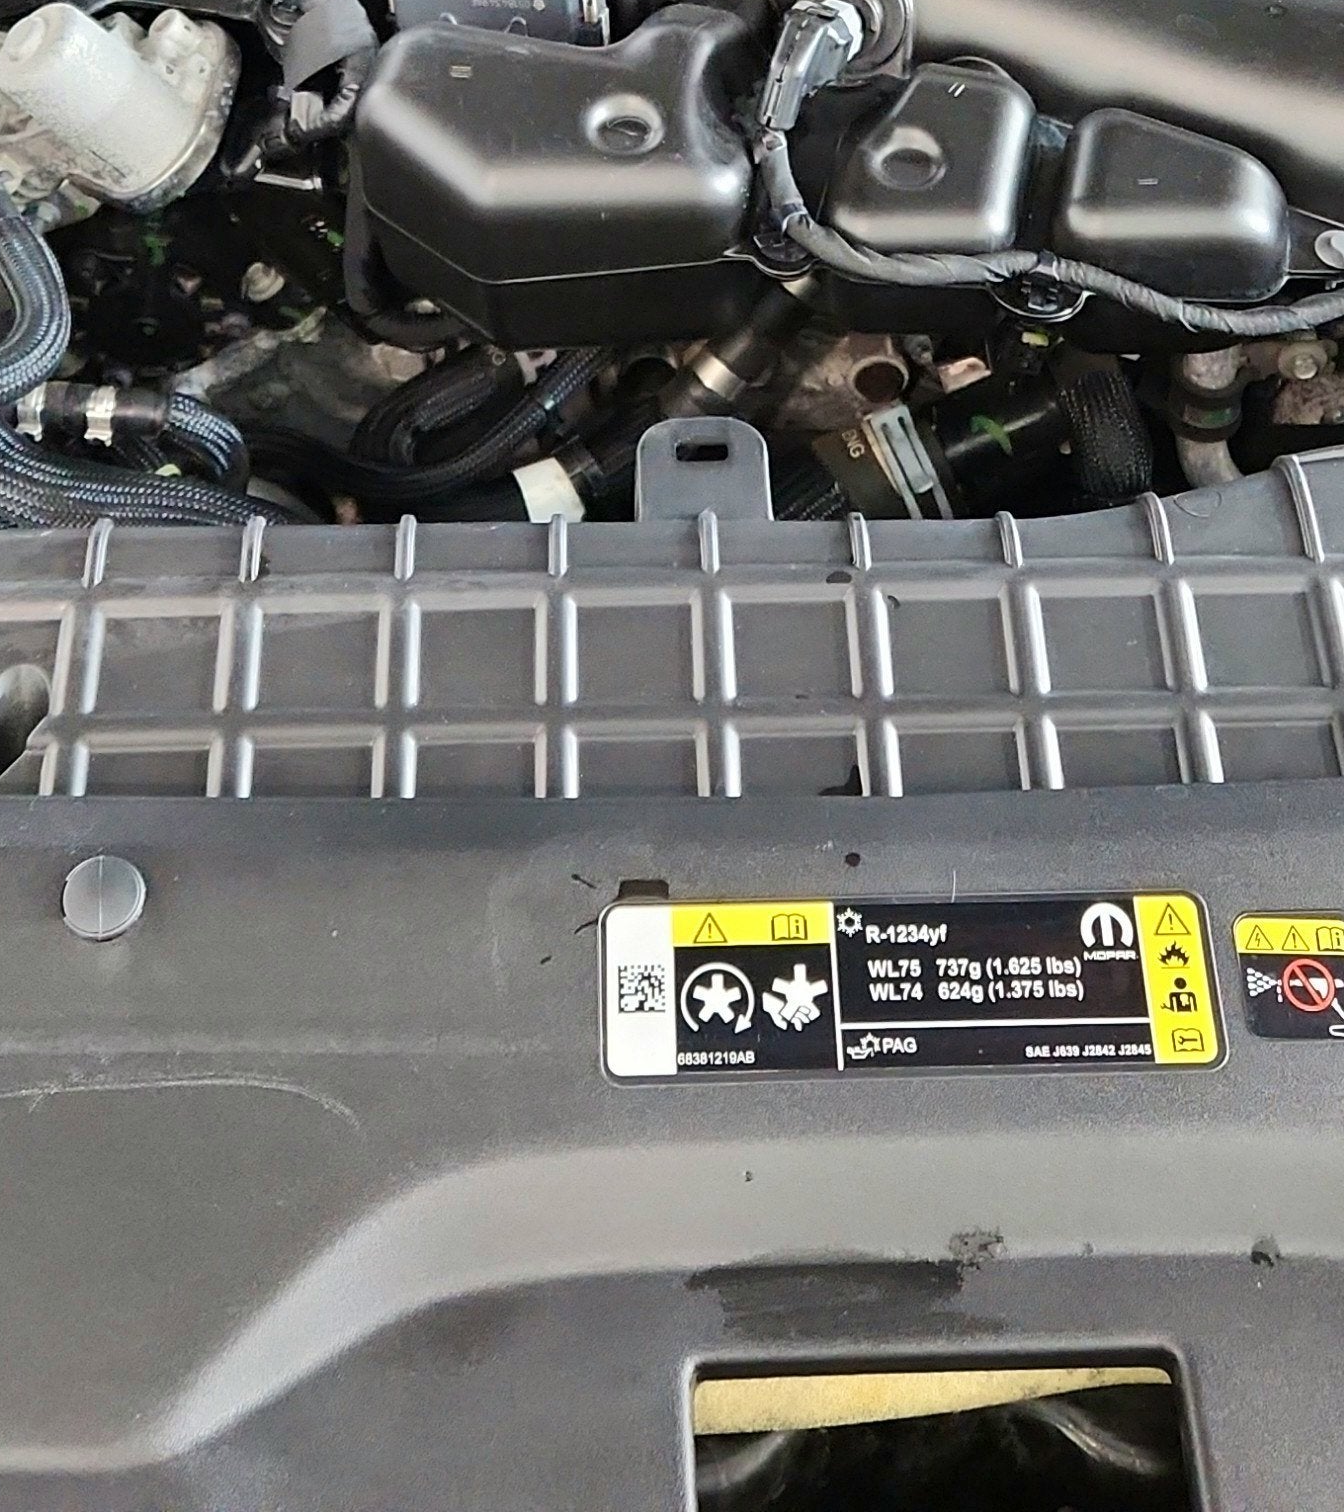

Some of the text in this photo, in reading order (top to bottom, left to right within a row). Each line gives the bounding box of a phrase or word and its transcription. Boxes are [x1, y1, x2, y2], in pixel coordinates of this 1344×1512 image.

[865, 923, 948, 946] R-1234yf
[1083, 949, 1137, 962] MOPAR
[867, 955, 1082, 980] WL75 737g (1.625 lbs)
[869, 979, 1085, 1004] WL74 624g (1.375 lbs)
[882, 1036, 918, 1054] PAG
[1025, 1042, 1152, 1058] SAE J639 J2842 J2845
[677, 1050, 756, 1065] 68381219AB
